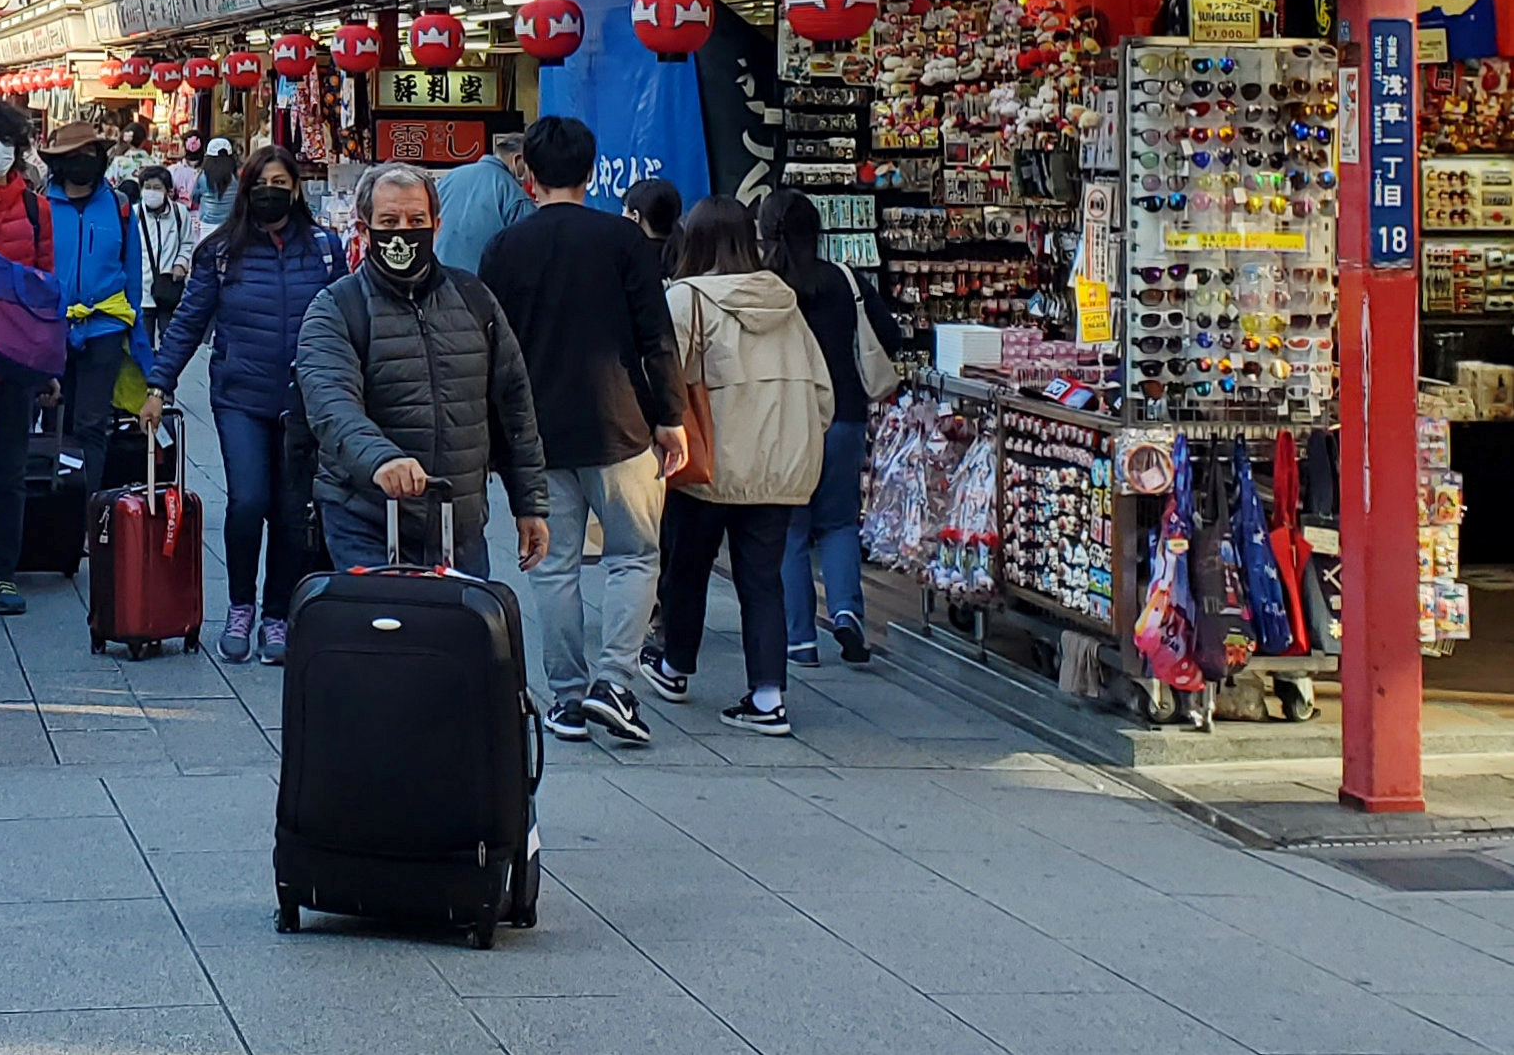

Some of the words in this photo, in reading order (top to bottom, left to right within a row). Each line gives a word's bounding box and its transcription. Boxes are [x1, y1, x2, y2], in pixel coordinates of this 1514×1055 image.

[393, 74, 482, 103] 評判堂
[1382, 74, 1407, 206] 浅草一丁目
[1379, 226, 1407, 253] 18
